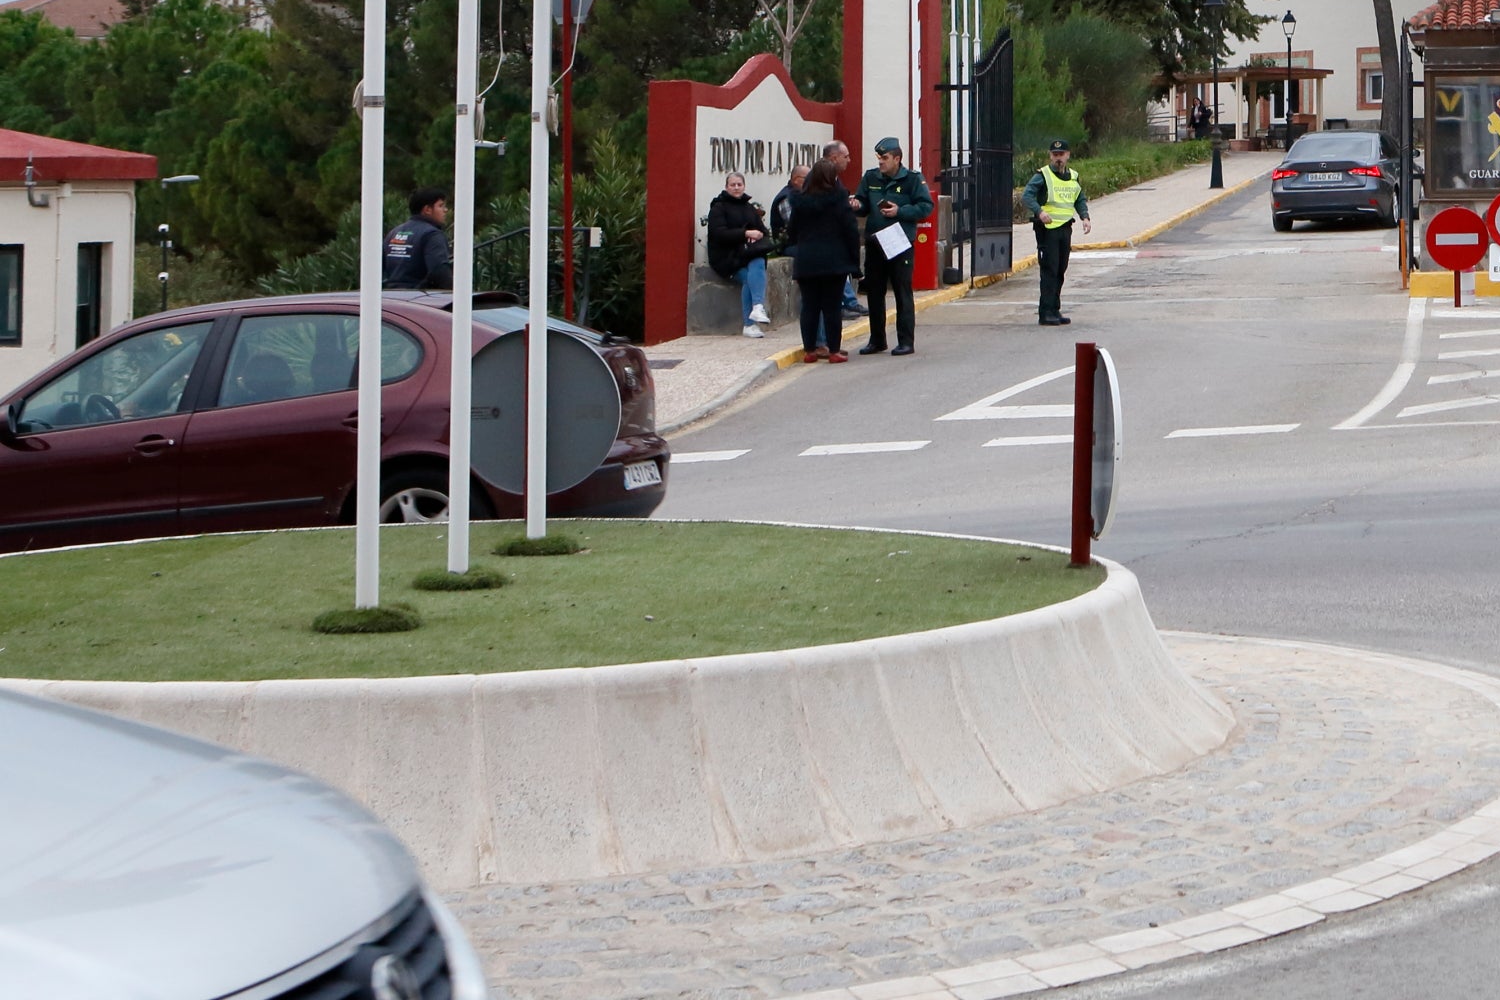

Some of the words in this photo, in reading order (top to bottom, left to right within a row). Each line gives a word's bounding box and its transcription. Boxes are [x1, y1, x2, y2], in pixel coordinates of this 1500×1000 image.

[710, 136, 741, 174] TODO
[744, 139, 765, 175] POR
[768, 141, 783, 175] LA
